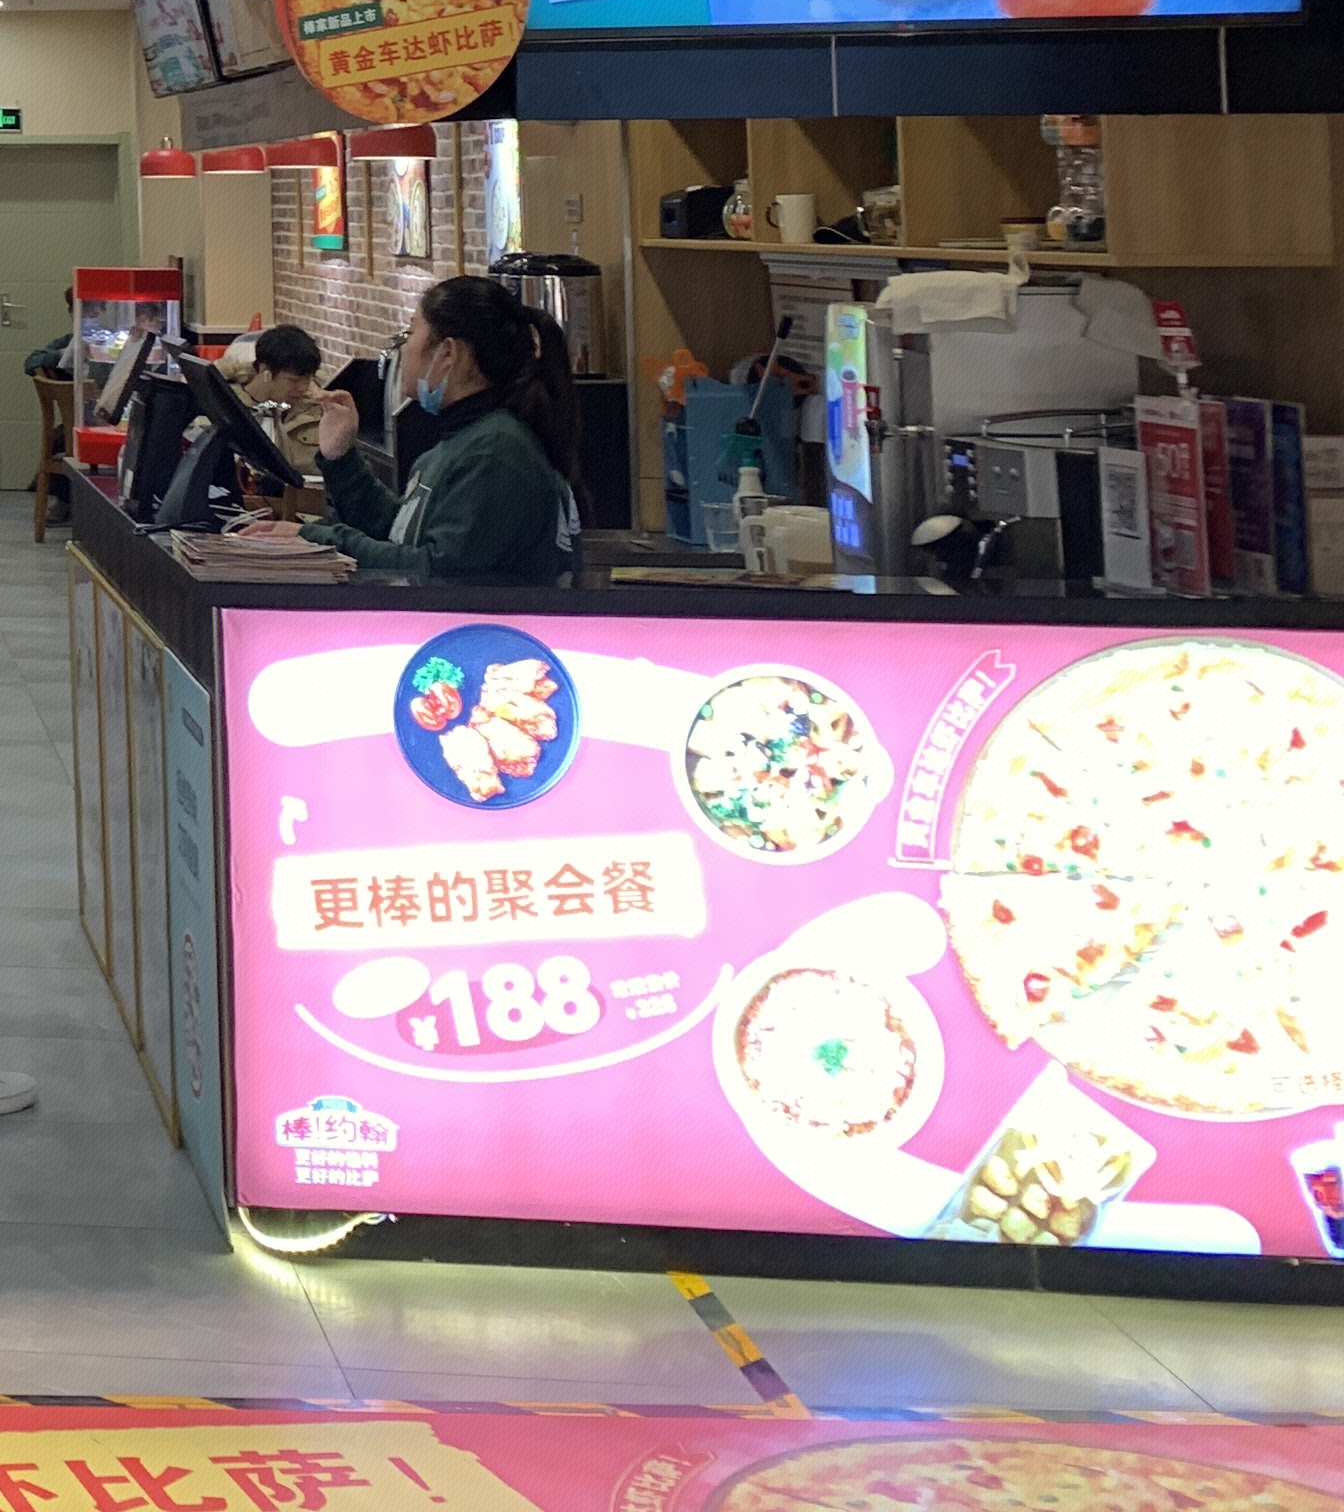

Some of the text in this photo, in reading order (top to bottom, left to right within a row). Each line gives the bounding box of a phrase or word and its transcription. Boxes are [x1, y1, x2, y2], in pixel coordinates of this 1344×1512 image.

[311, 861, 656, 930] 更棒的聚会餐
[282, 1115, 389, 1145] 棒!约翰
